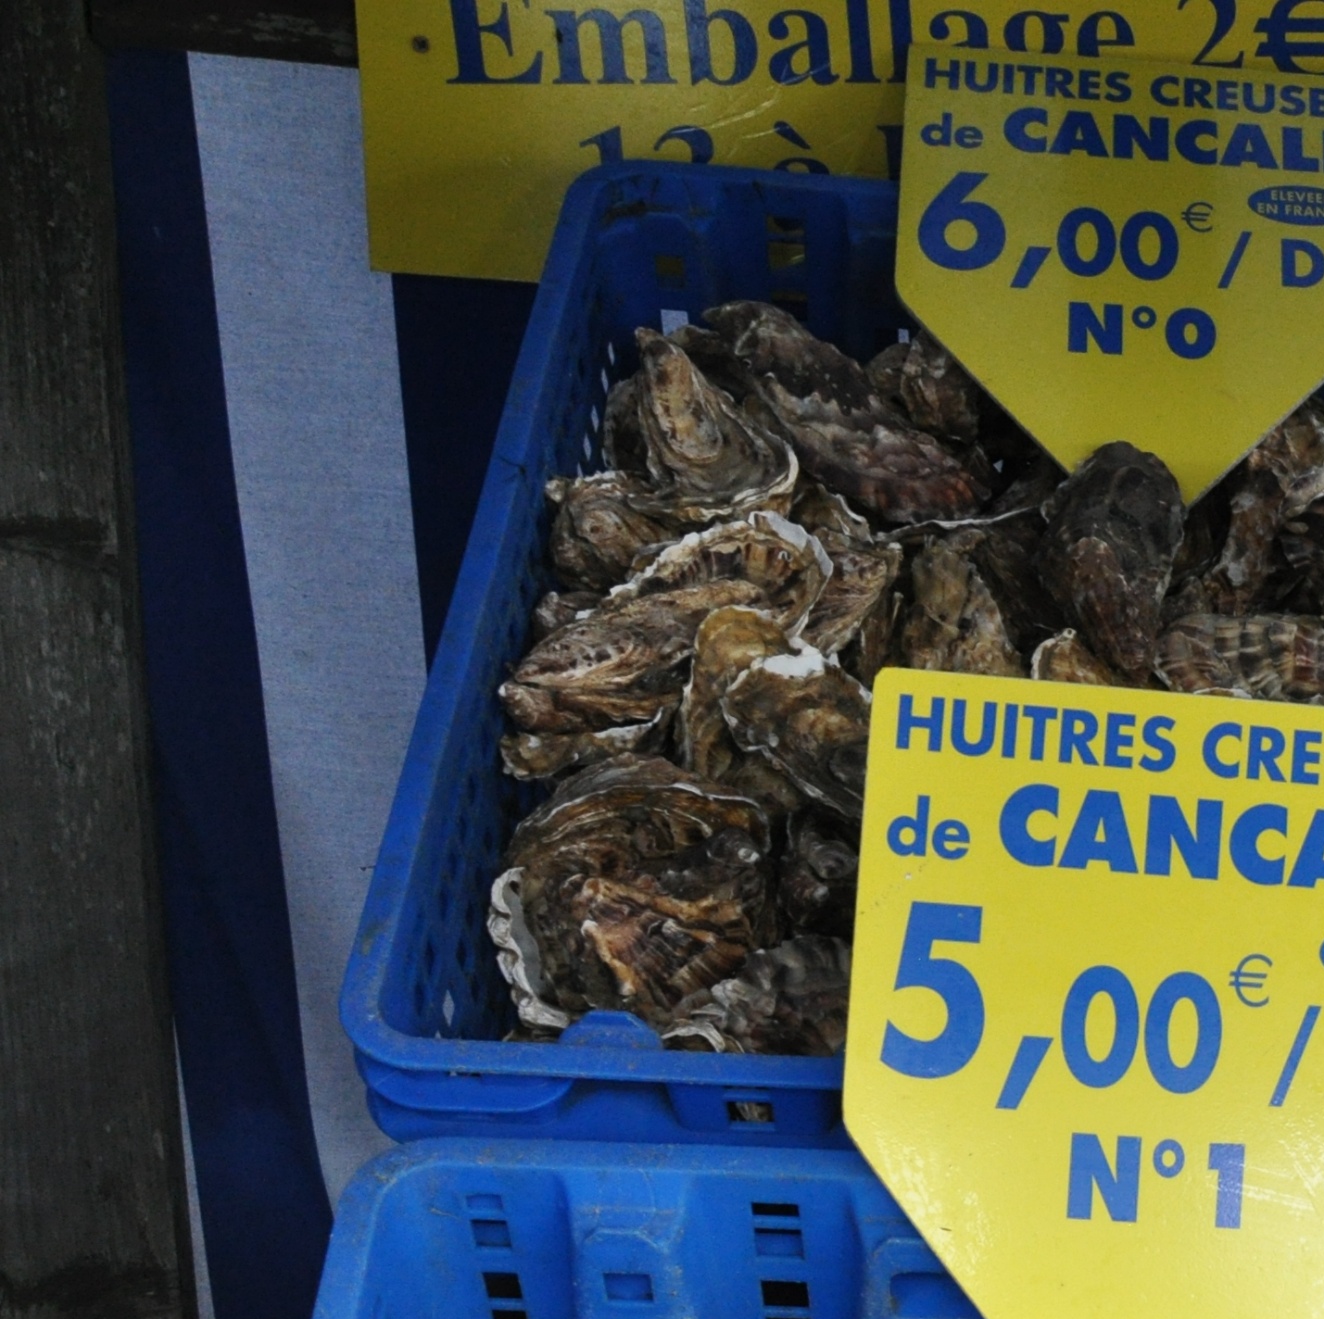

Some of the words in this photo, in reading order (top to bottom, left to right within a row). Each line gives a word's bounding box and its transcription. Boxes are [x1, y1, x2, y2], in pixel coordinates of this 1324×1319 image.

[924, 58, 1132, 102] HUITRES
[920, 113, 984, 150] de
[1257, 204, 1279, 216] EN
[895, 694, 1178, 772] HUITRES
[886, 795, 971, 860] de
